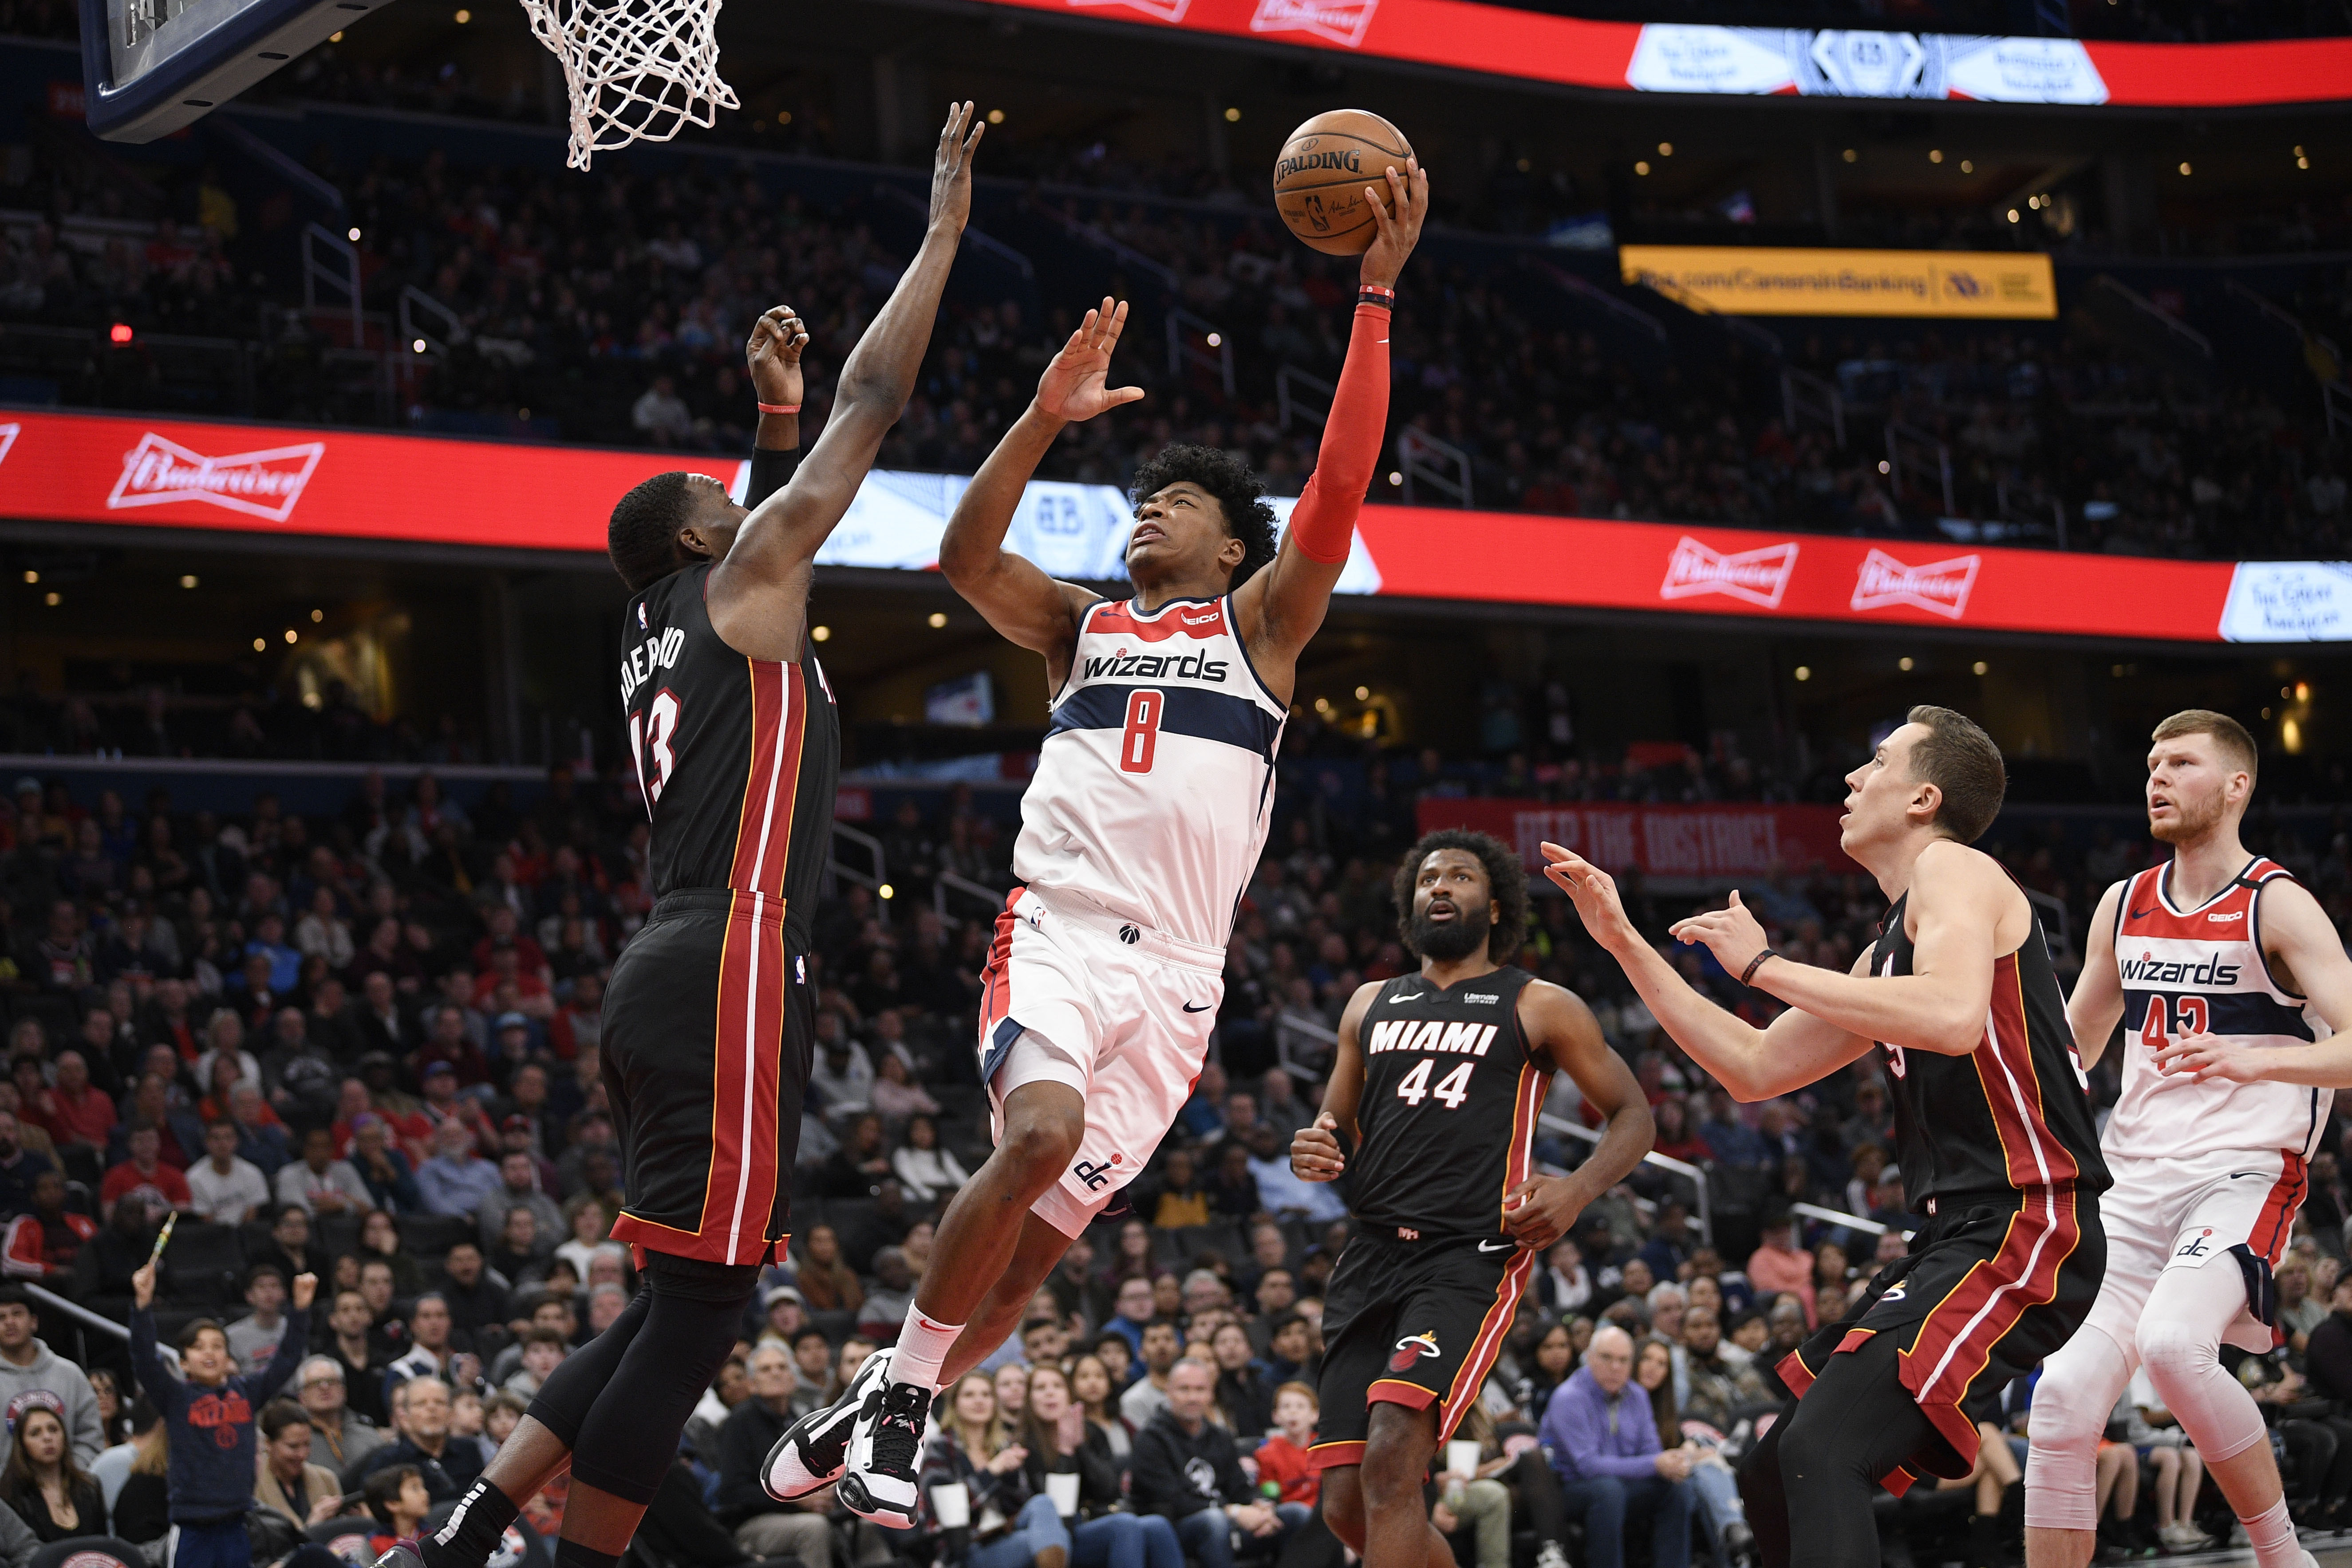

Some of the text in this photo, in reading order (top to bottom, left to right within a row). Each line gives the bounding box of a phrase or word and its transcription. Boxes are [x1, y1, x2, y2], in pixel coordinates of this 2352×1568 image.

[1276, 150, 1360, 186] SPALDING
[123, 448, 303, 496] Budweiser
[1181, 612, 1219, 625] GEICO
[1084, 647, 1229, 683] wizards
[1119, 690, 1164, 775] 8
[2207, 911, 2243, 922] GEICO
[2121, 951, 2242, 986] wizards
[1369, 1020, 1500, 1056] MIAMI
[1397, 1057, 1476, 1109] 44
